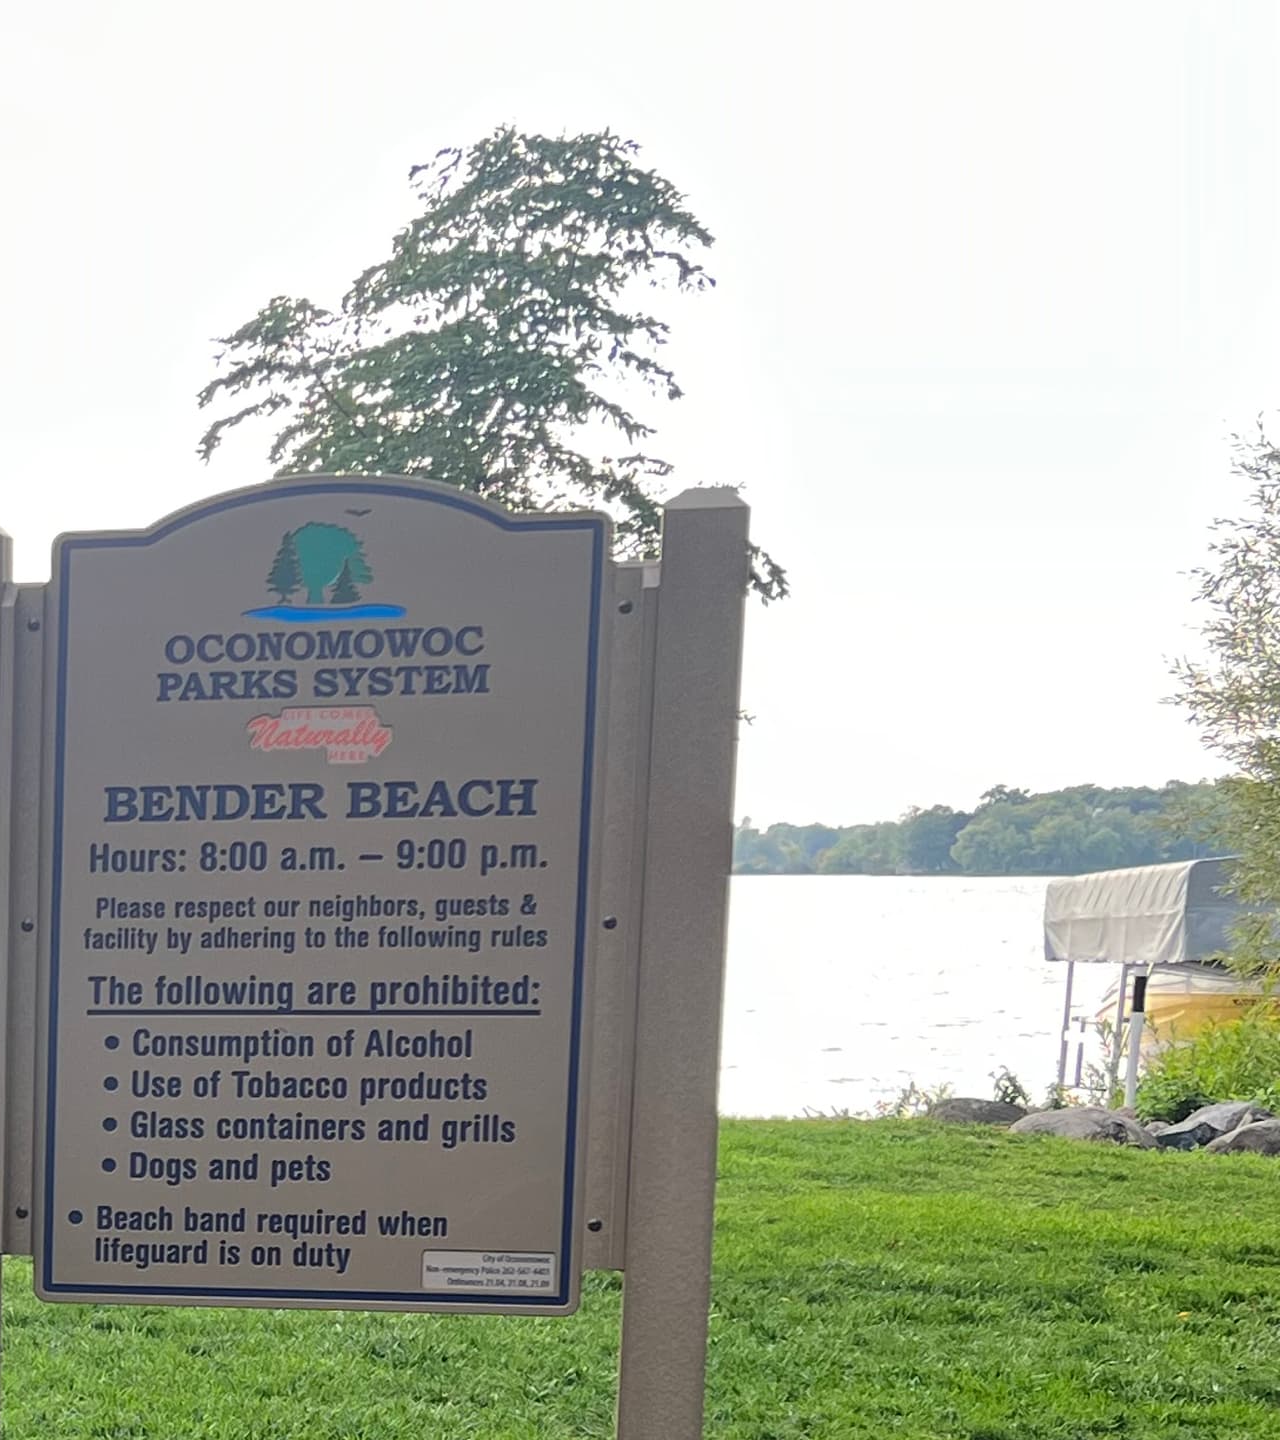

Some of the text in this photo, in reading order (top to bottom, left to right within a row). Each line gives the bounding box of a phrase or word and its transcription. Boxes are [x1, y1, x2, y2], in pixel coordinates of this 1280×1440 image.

[165, 626, 484, 664] OCONOMOWOC
[157, 664, 490, 702] PARKS SYSTEM
[248, 718, 389, 753] Naturally
[104, 778, 538, 823] BENDER BEACH
[89, 843, 186, 874] Hours:
[200, 841, 267, 873] 8:00
[280, 847, 345, 872] a.m.
[396, 839, 466, 870] 9:00
[481, 845, 548, 876] p.m.
[96, 894, 537, 923] Please respect our neighbors, guests &
[84, 926, 548, 954] facility by adhering to the following rules
[88, 975, 540, 1011] The following are prohibited:
[132, 1029, 472, 1062] Consumption of Alcohol
[131, 1072, 488, 1104] Use of Tobacco products
[130, 1112, 515, 1148] Glass containers and grills
[130, 1153, 331, 1186] Dogs and pets
[96, 1206, 448, 1238] Beach band required when
[95, 1240, 350, 1274] lifeguard is on duty
